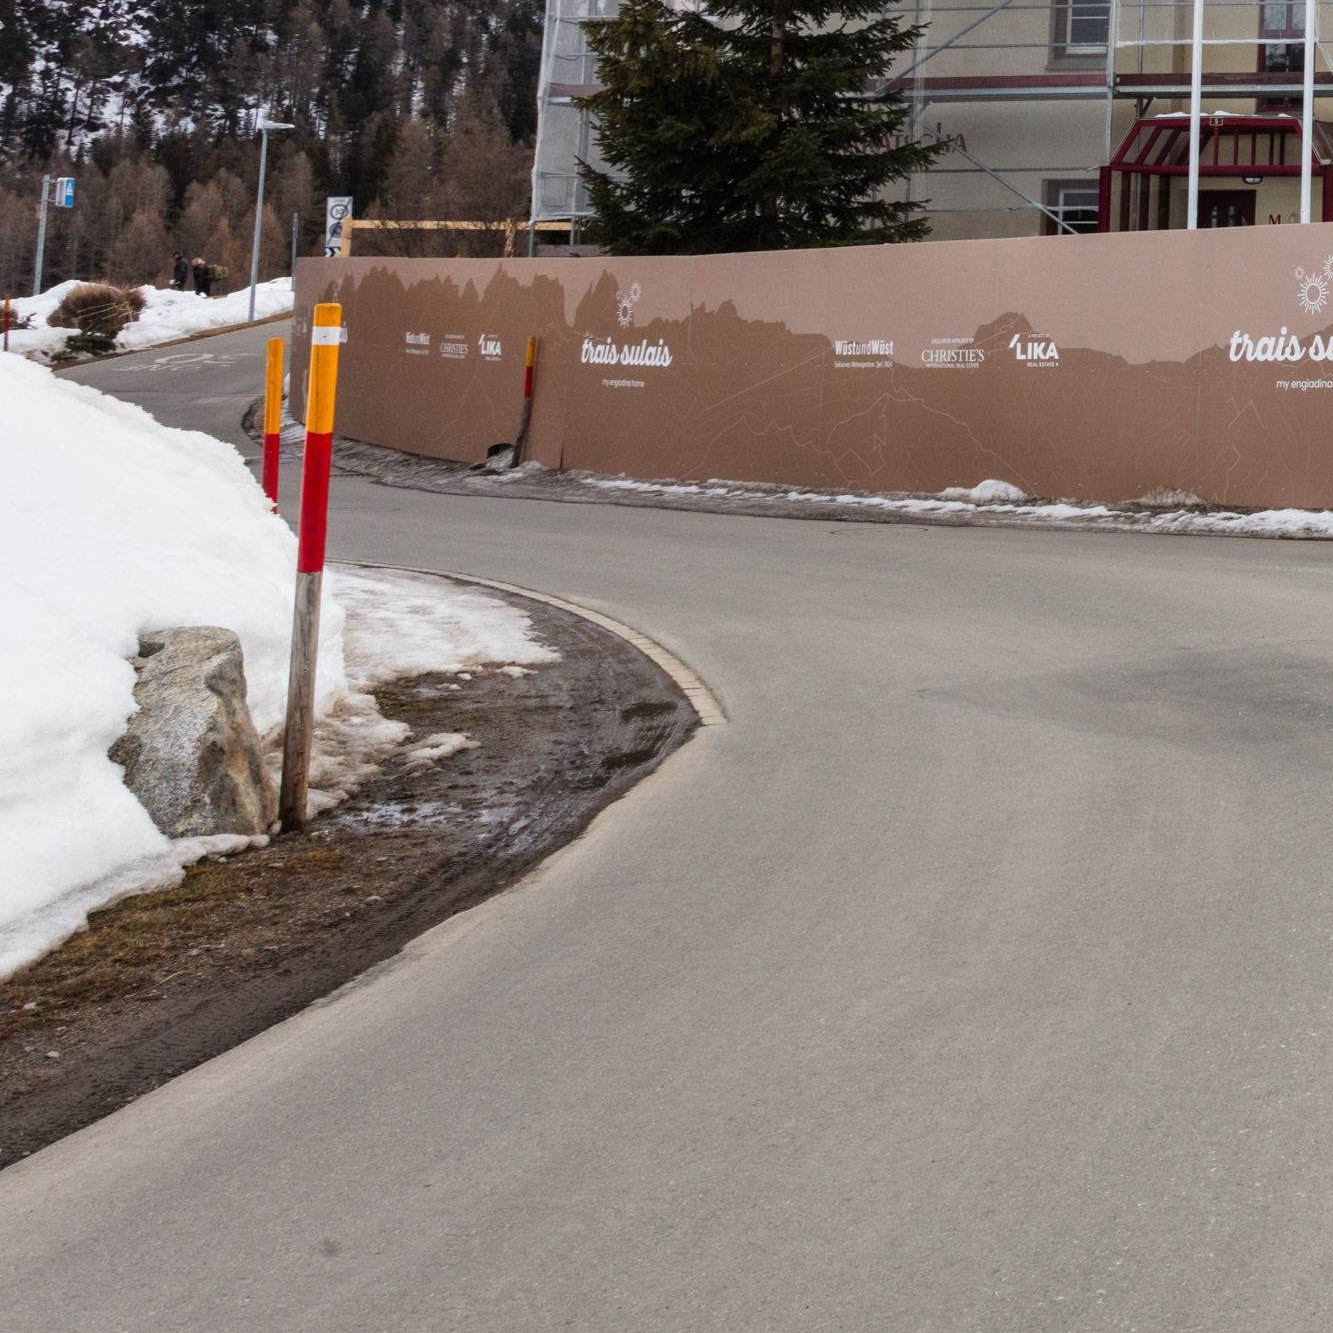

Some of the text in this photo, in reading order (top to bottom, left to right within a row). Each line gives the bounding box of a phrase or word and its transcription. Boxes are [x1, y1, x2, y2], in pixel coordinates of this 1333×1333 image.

[481, 340, 502, 355] LIKA
[581, 337, 673, 367] trais sulais
[835, 340, 894, 355] WüstundWüst
[1016, 342, 1059, 360] LIKA
[1229, 326, 1306, 362] trais
[1276, 380, 1289, 391] my
[1291, 379, 1333, 391] engiadina
